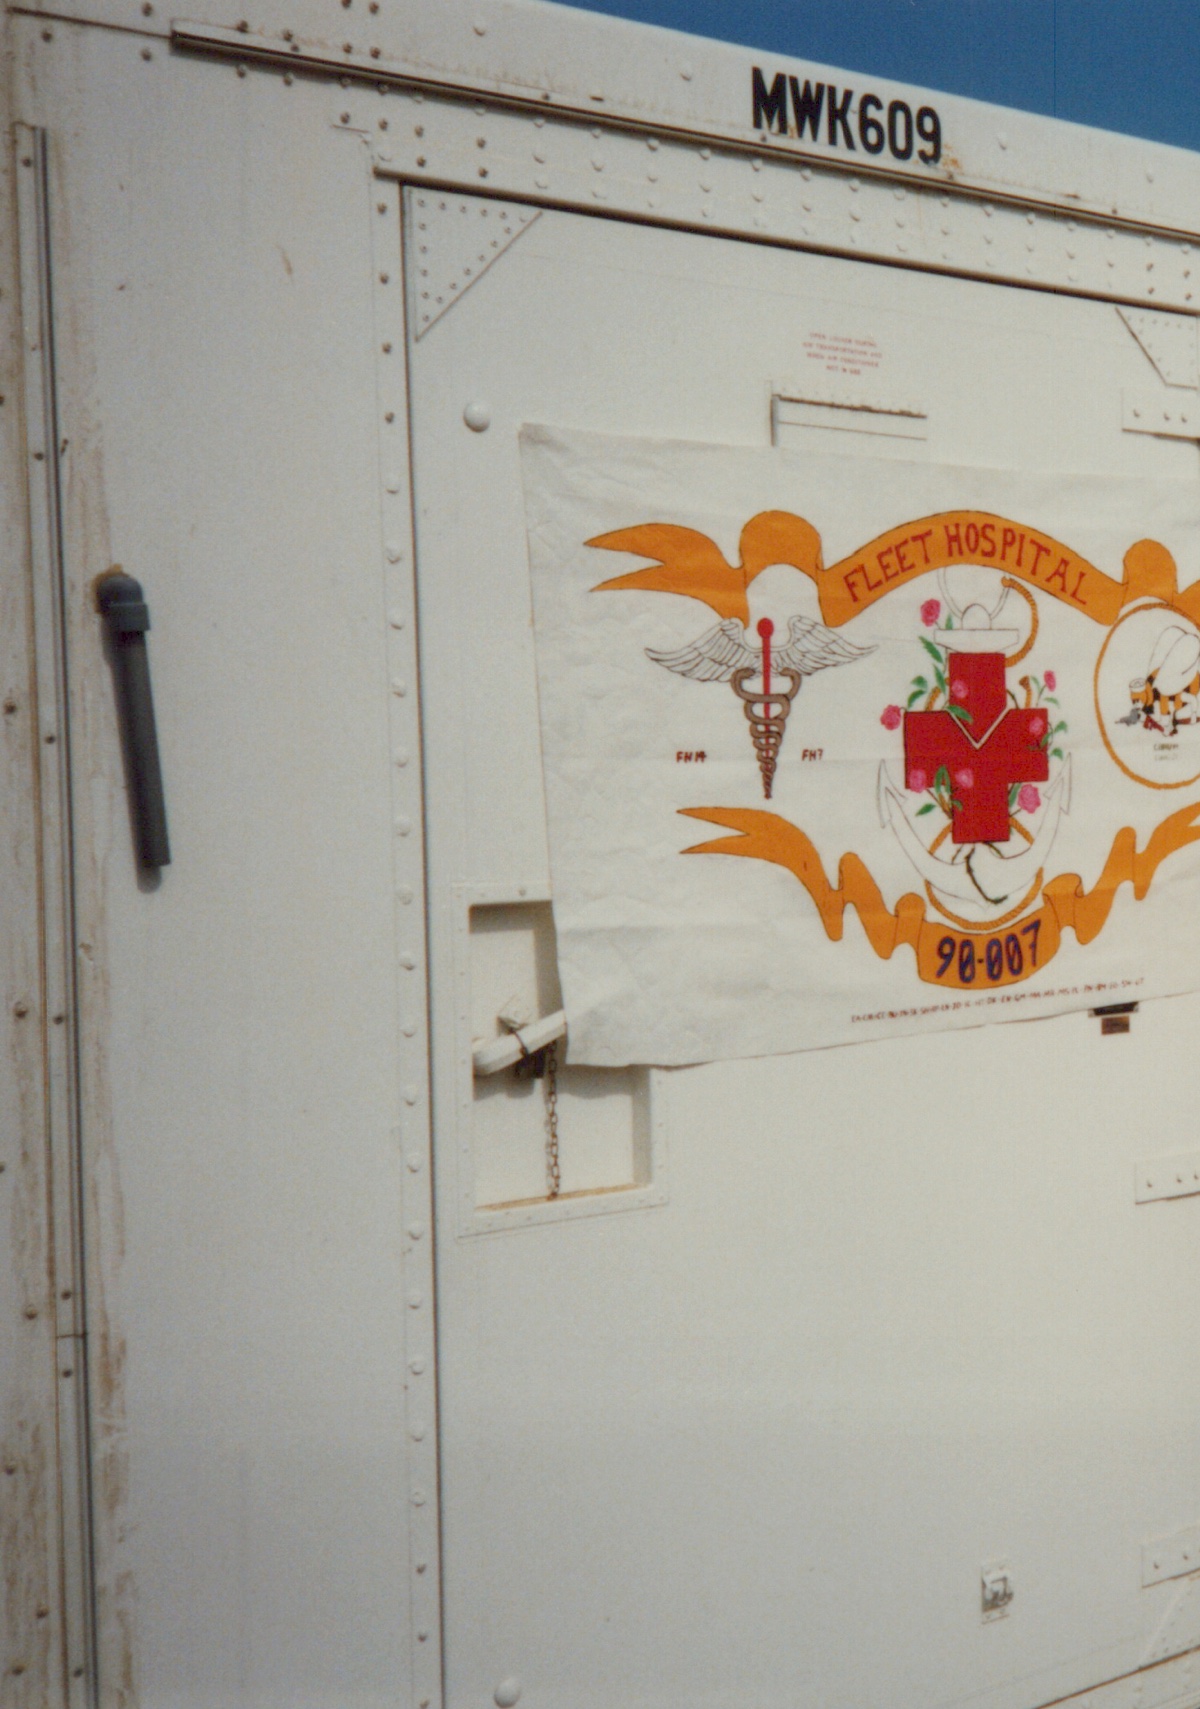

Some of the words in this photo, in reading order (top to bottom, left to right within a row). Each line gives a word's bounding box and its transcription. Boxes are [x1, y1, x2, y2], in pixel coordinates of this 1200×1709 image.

[752, 66, 941, 165] MWK609
[844, 529, 933, 603] FLEET
[944, 523, 1087, 605] HOSPITAL
[936, 919, 1041, 983] 90-007
